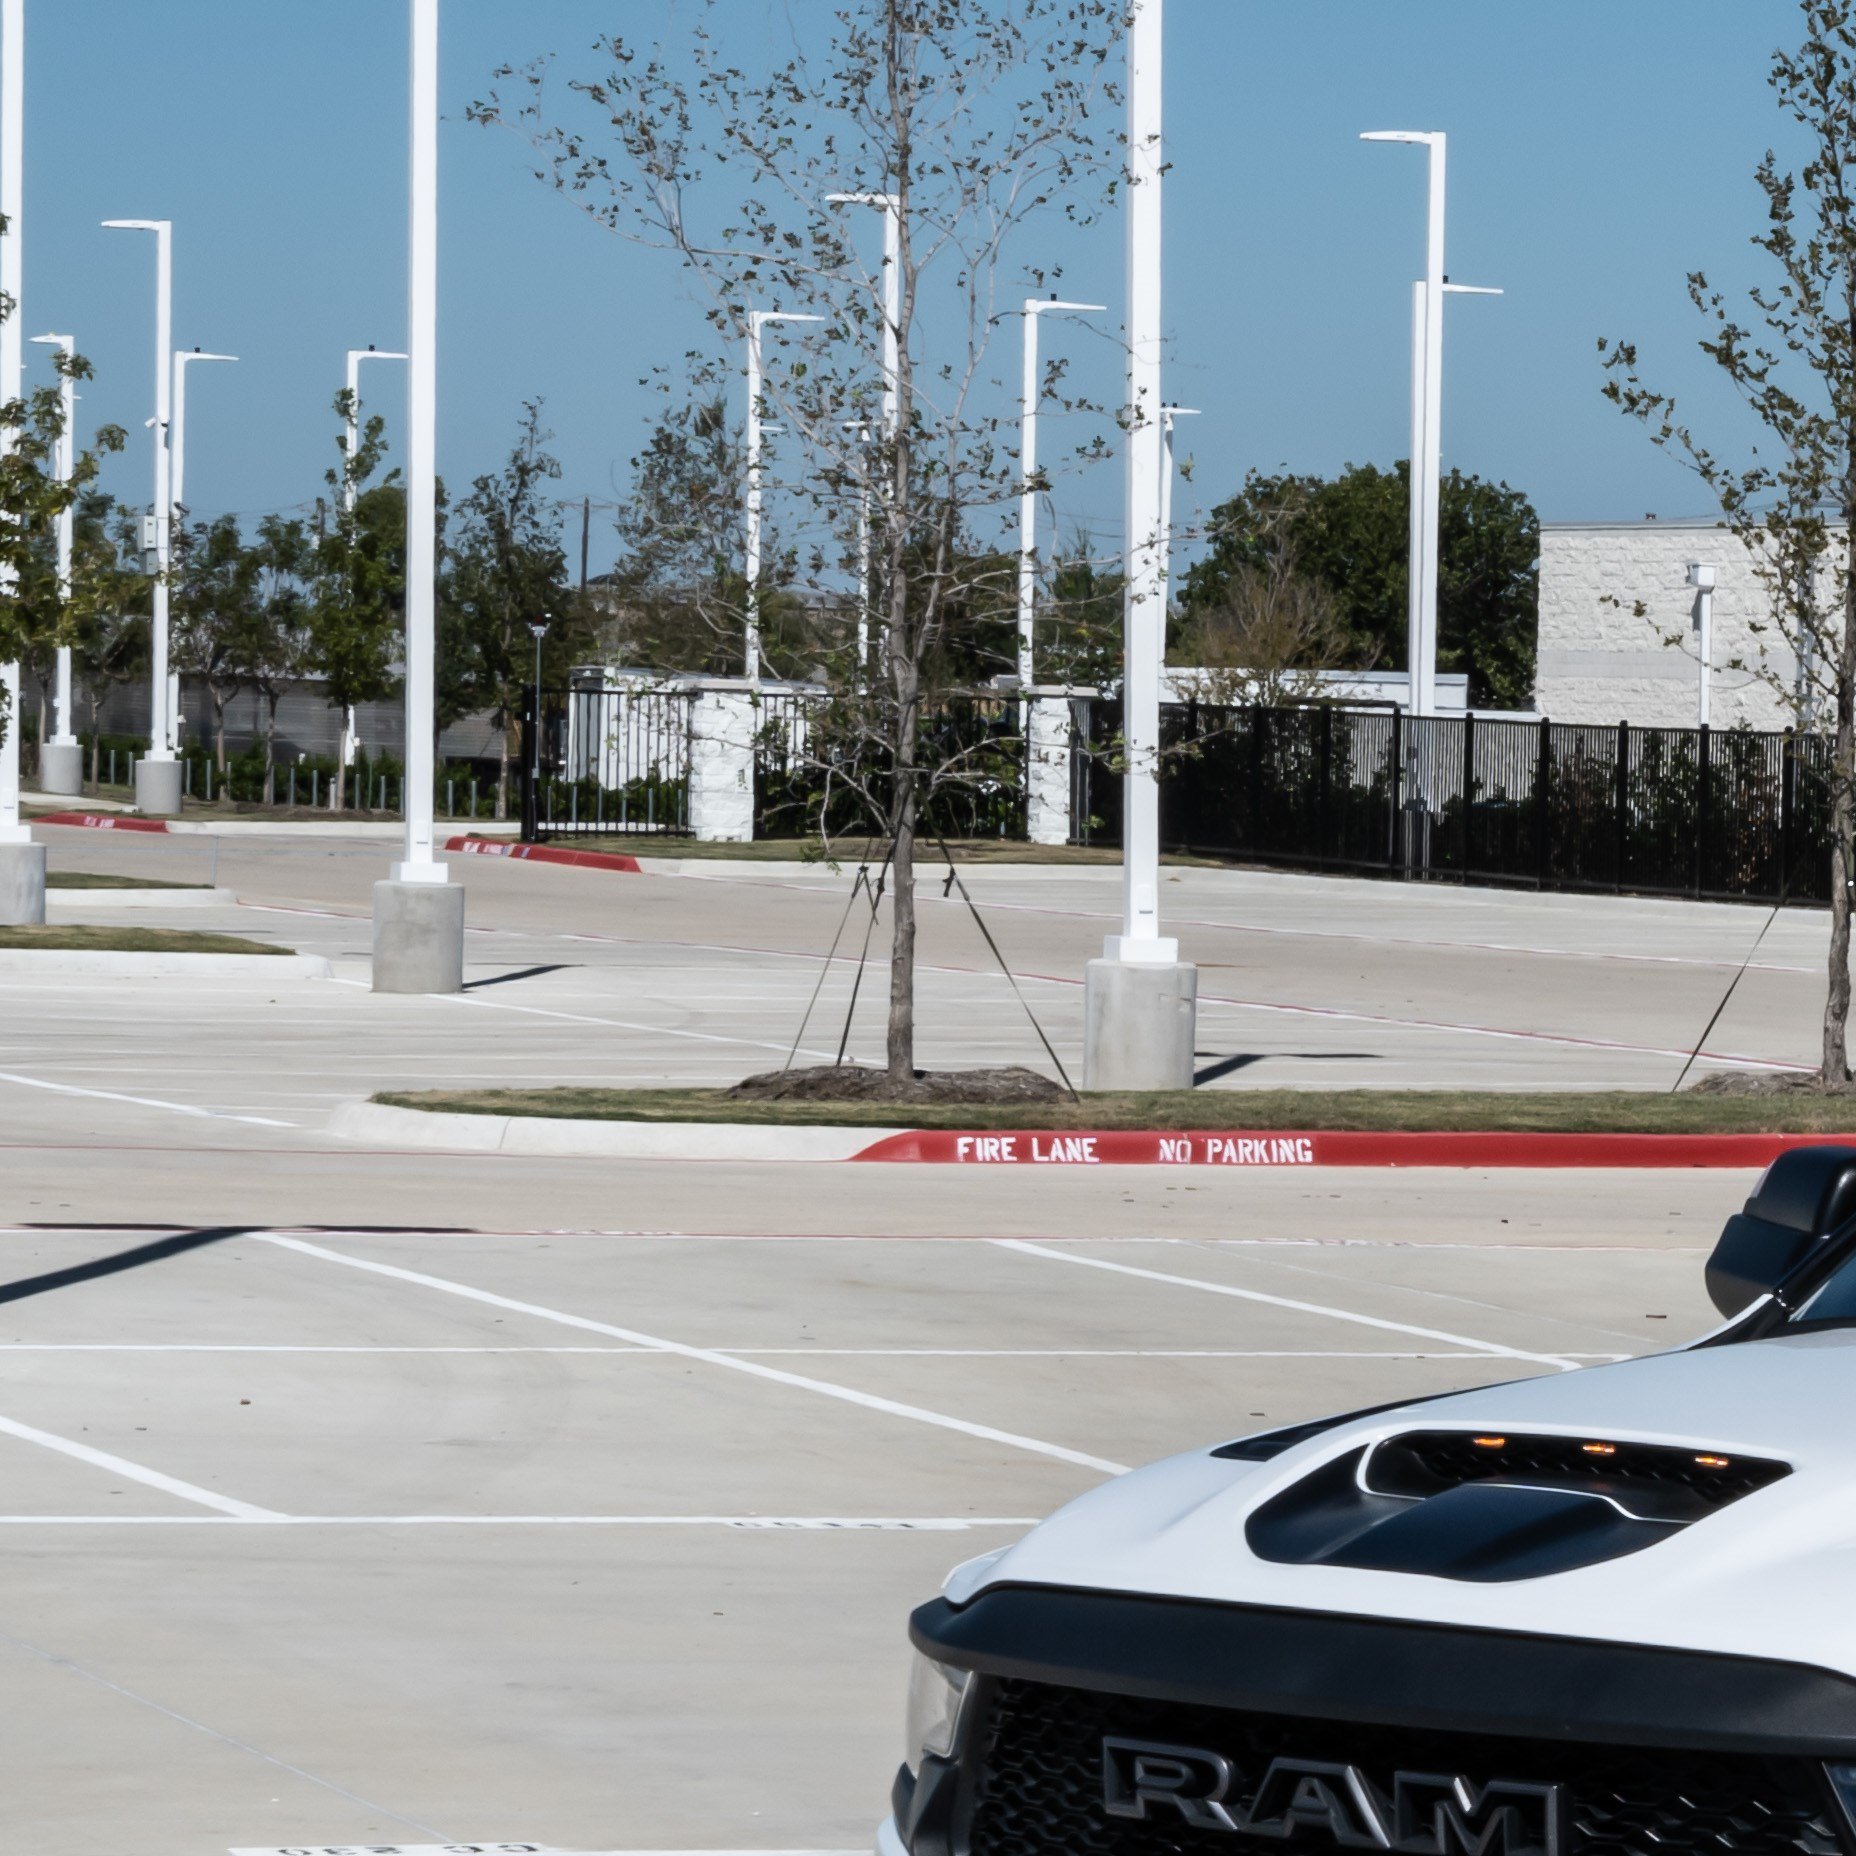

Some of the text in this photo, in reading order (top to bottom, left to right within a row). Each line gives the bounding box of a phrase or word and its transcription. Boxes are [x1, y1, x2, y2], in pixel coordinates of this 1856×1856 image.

[957, 1137, 1313, 1165] FIRE LANE NO PARKING
